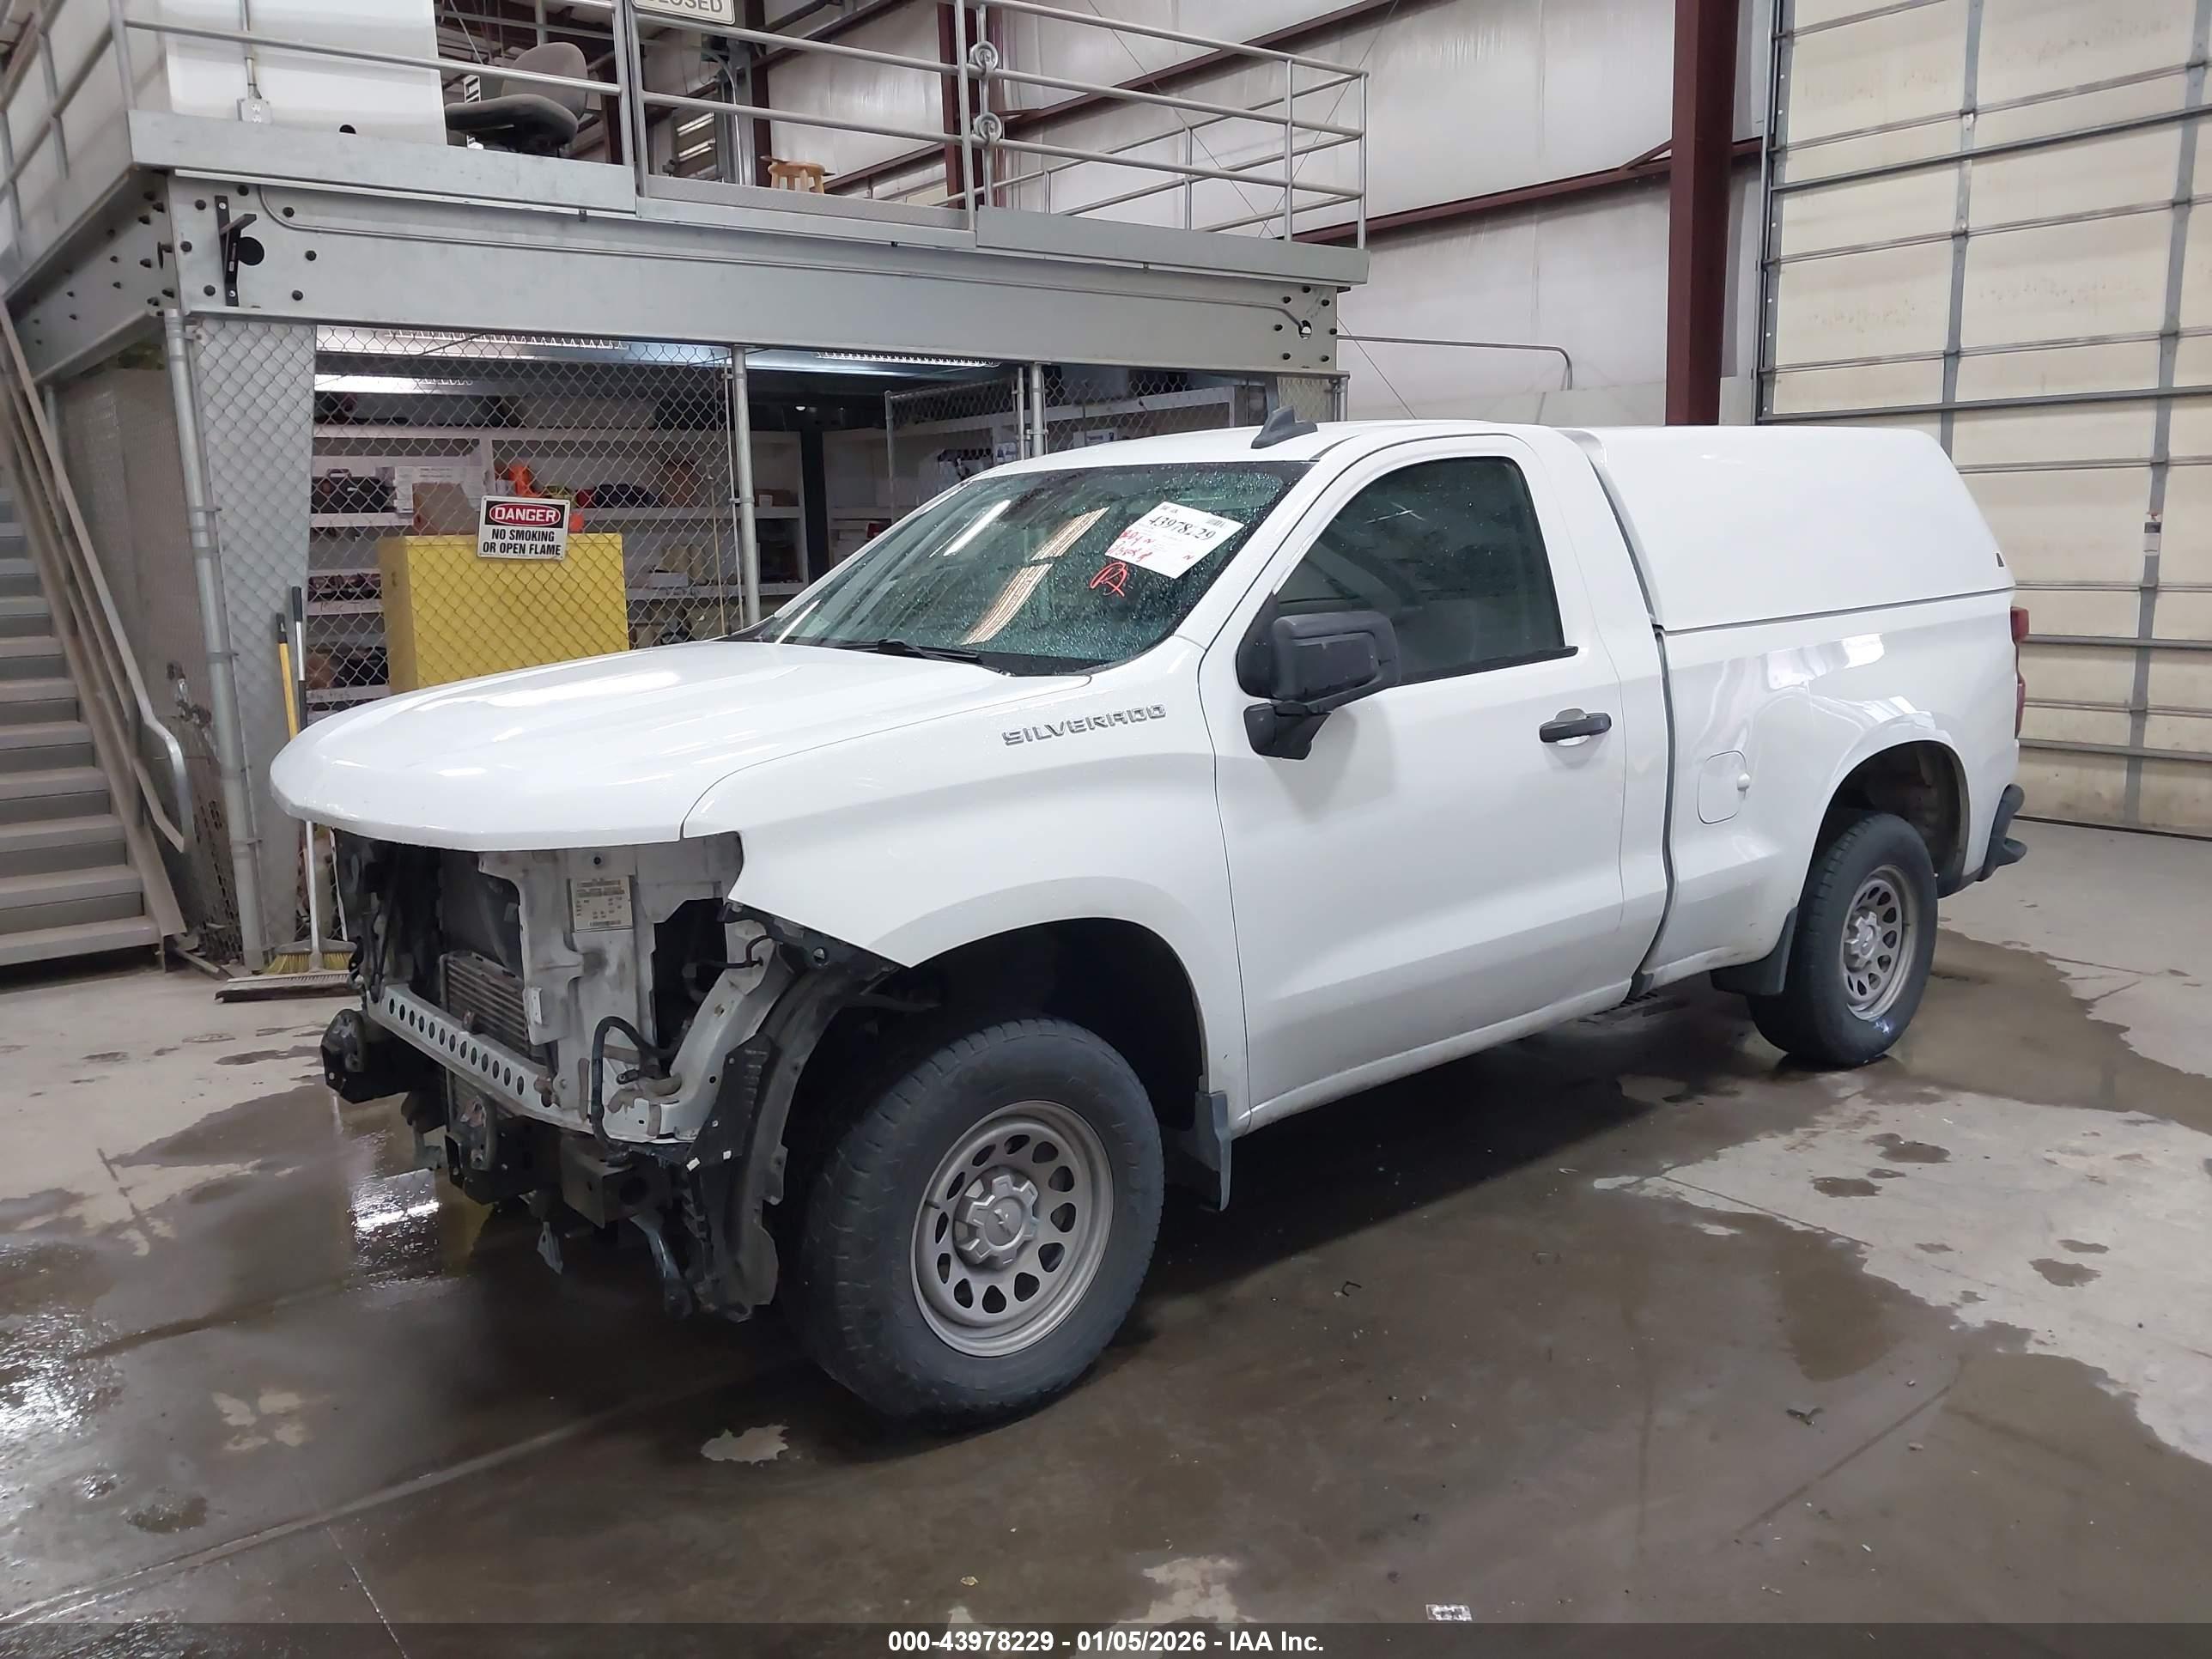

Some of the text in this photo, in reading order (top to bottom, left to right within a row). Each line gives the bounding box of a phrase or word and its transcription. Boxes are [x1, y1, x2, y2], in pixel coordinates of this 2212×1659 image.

[659, 0, 722, 12] SED
[495, 507, 556, 522] DANGER
[491, 528, 555, 542] NO SMOKING
[483, 542, 561, 556] OR OPEN FLAME
[1001, 704, 1166, 745] SILVERADO
